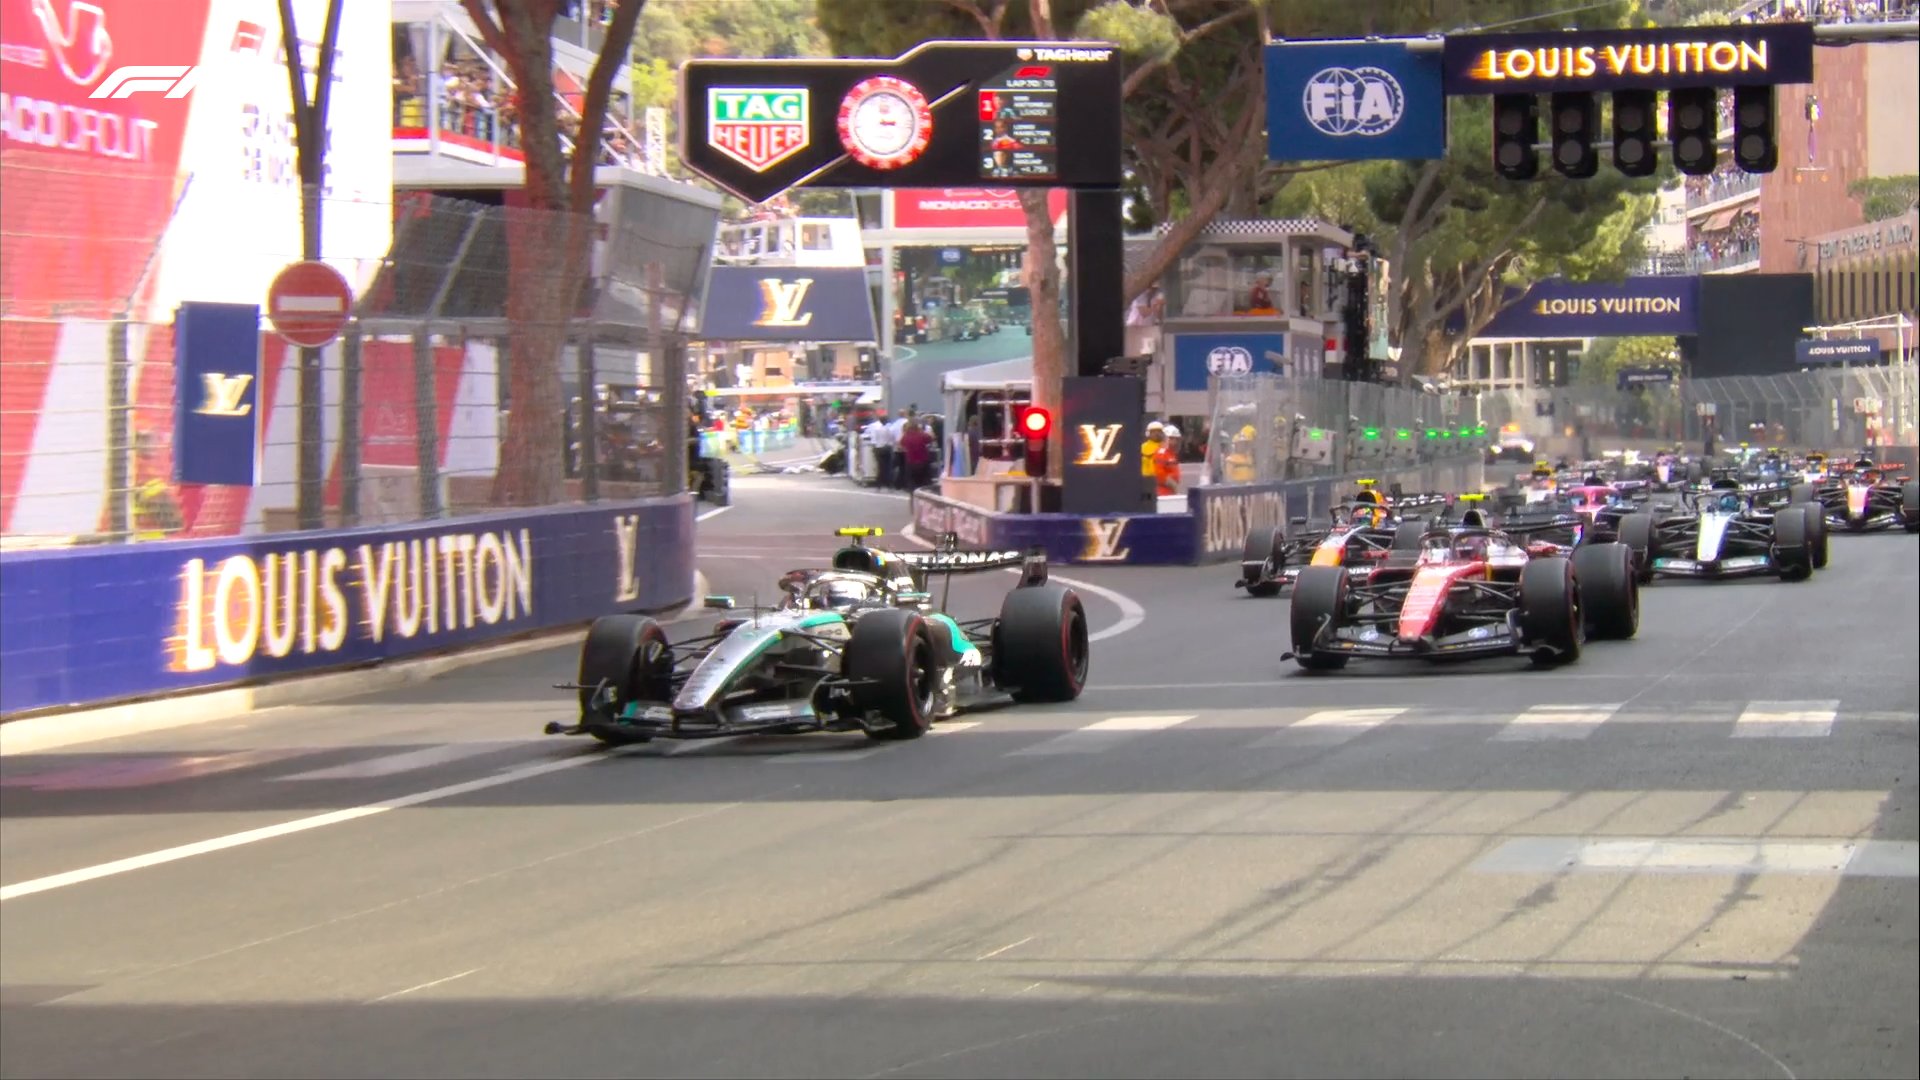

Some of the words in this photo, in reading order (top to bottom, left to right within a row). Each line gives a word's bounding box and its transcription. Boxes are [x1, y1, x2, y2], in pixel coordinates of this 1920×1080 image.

[1487, 45, 1597, 80] LOUIS
[1606, 39, 1768, 75] VUITTON
[718, 95, 800, 119] TAG
[983, 100, 993, 111] 1
[716, 126, 801, 162] HEUER
[983, 129, 993, 140] 2
[983, 158, 994, 168] 3
[756, 278, 814, 327] LV
[1543, 298, 1597, 315] LOUIS
[1601, 296, 1681, 314] VUITTON
[1076, 424, 1123, 465] LV
[1080, 517, 1131, 561] LV
[180, 546, 347, 672] LOUIS
[358, 526, 534, 644] VUITTON
